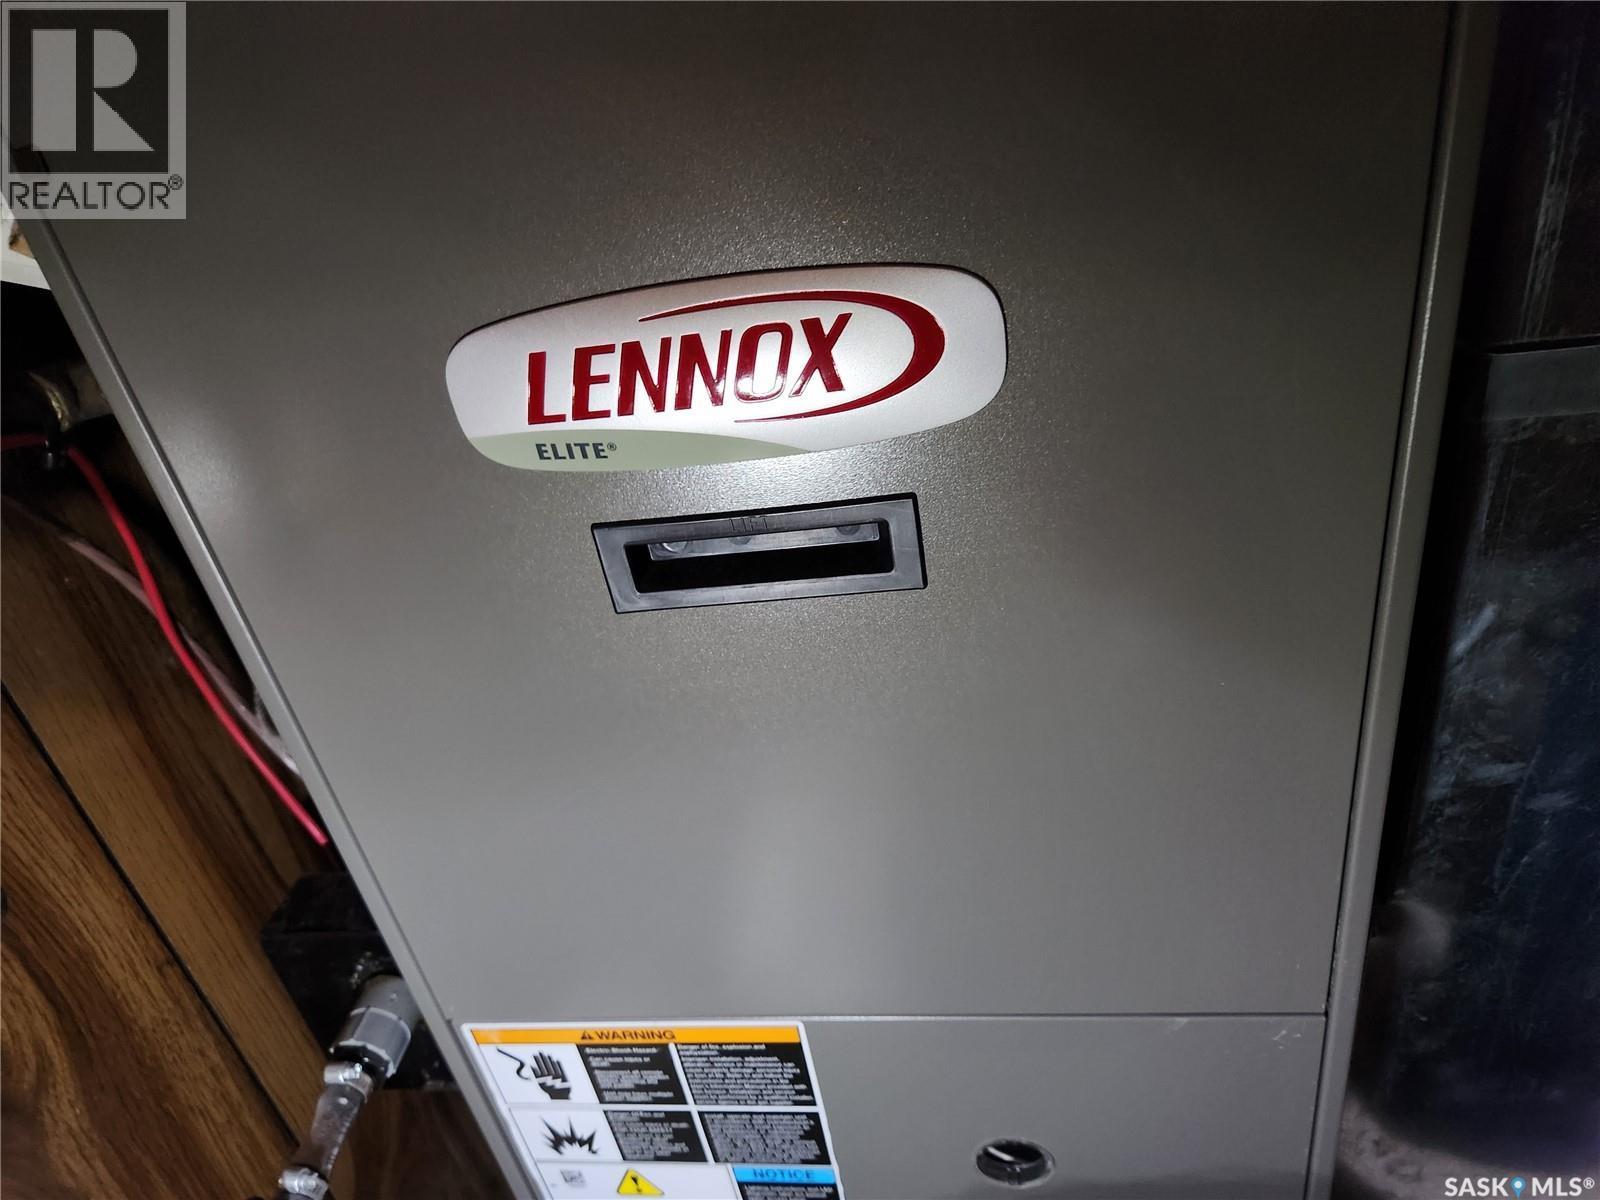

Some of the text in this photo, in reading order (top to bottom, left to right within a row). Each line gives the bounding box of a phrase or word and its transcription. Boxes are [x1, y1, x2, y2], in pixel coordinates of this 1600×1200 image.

[527, 312, 853, 425] LENNOX
[535, 441, 617, 460] ELITE®
[594, 1029, 676, 1040] WARNING
[752, 1168, 816, 1180] NOTICE
